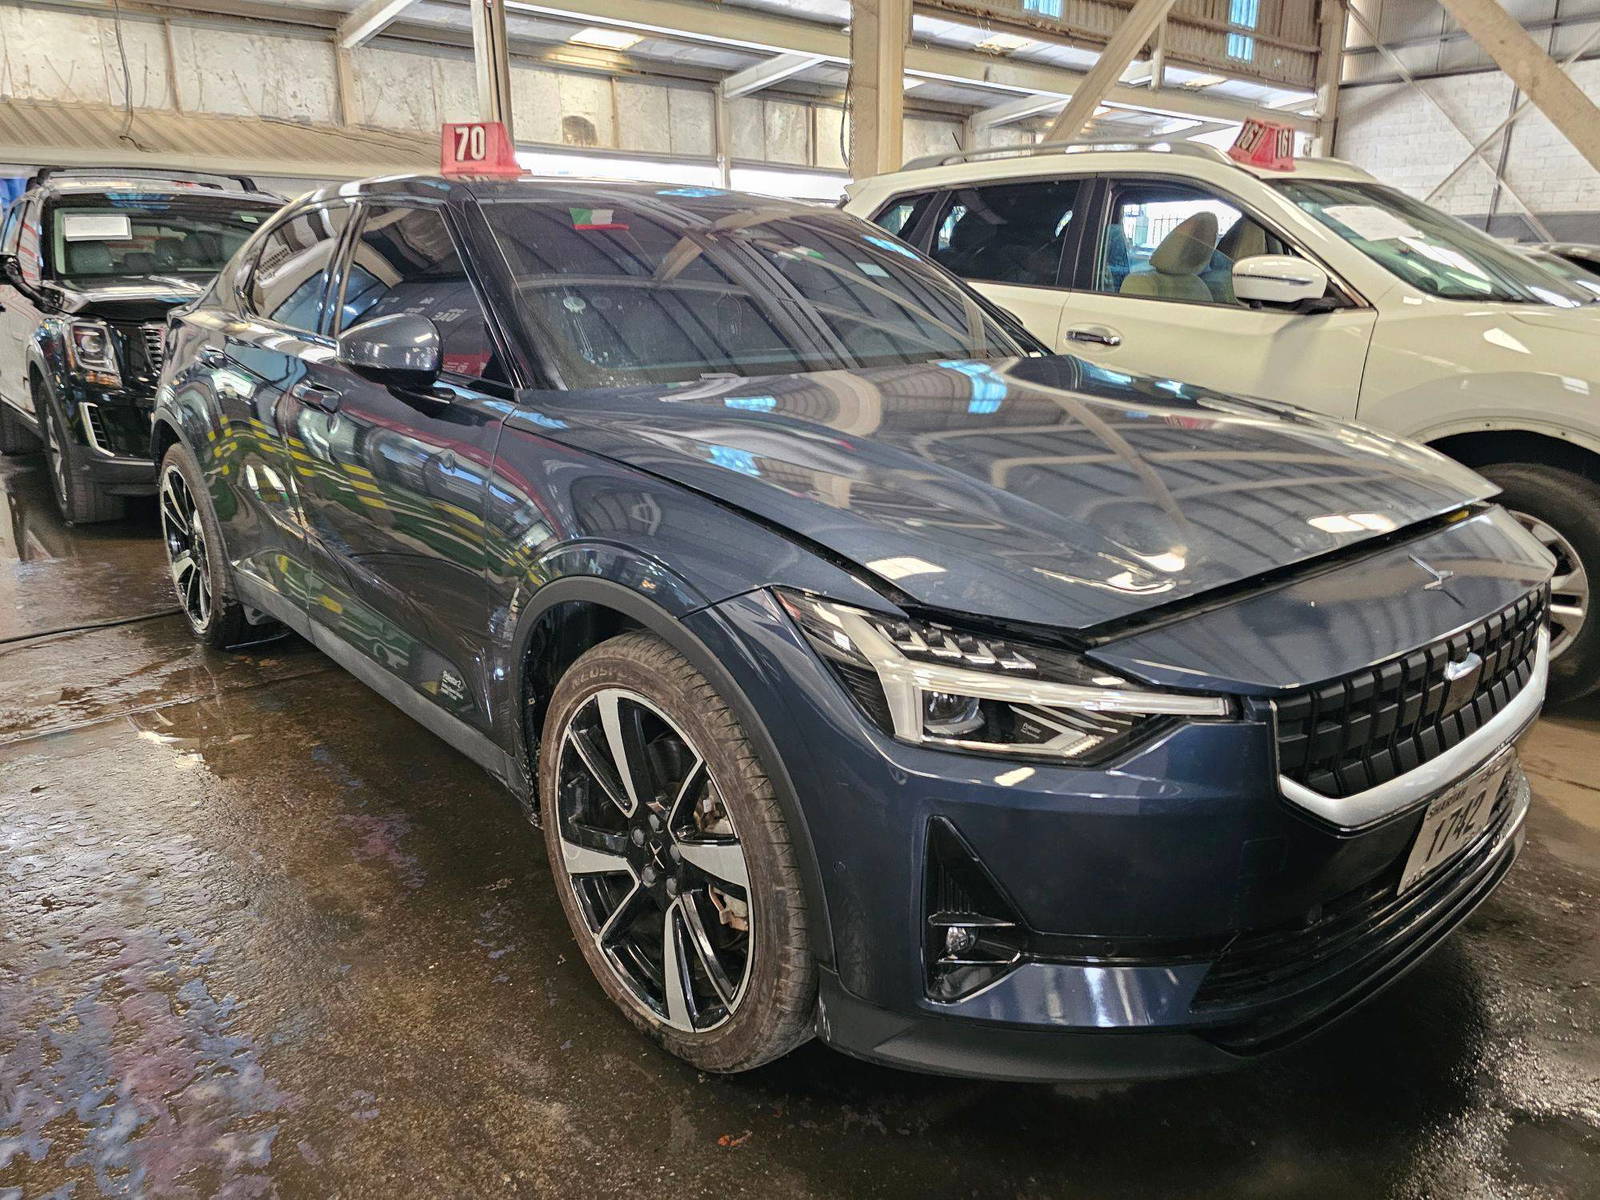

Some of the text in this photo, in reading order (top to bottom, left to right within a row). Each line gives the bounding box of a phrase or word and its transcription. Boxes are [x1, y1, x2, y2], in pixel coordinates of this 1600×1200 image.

[455, 126, 485, 161] 70
[1276, 128, 1293, 159] 161
[1426, 789, 1487, 862] 1742
